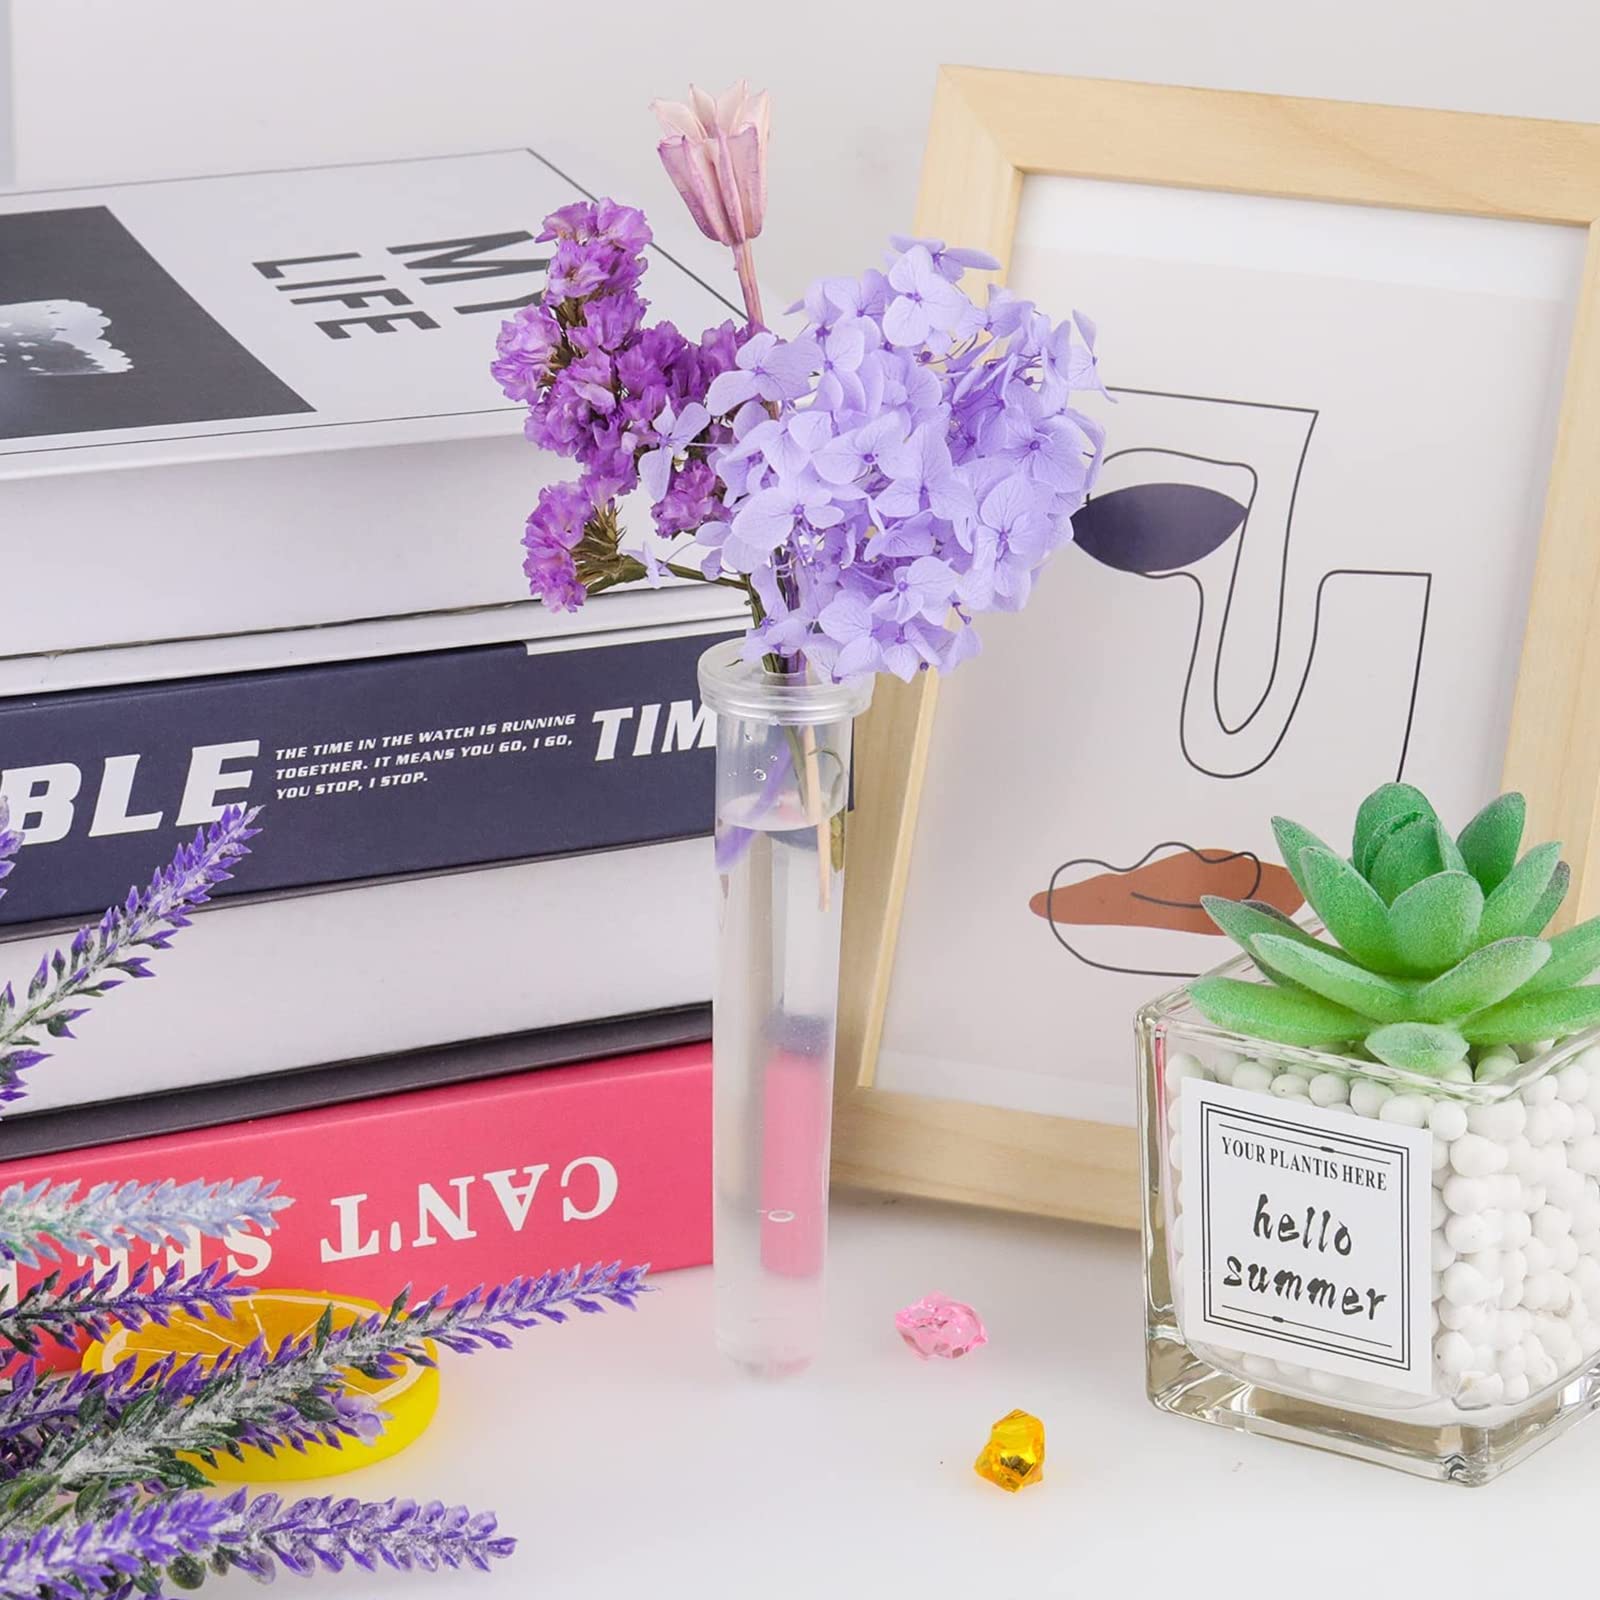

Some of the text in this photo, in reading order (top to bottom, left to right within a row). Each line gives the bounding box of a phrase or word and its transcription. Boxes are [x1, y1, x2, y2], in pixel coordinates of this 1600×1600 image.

[251, 252, 442, 340] LIFE
[275, 713, 577, 761] THE TIME IN THE WATCH IS RUNNING
[275, 734, 573, 780] TOGETHER. IT MEANS YOU GO, I GO,
[276, 771, 428, 800] YOU STOP, I STOP.
[1221, 1136, 1266, 1164] YOUR
[1342, 1164, 1387, 1191] HERE
[320, 1155, 619, 1263] CAN'T
[1253, 1193, 1352, 1256] hello
[1223, 1255, 1388, 1320] summer
